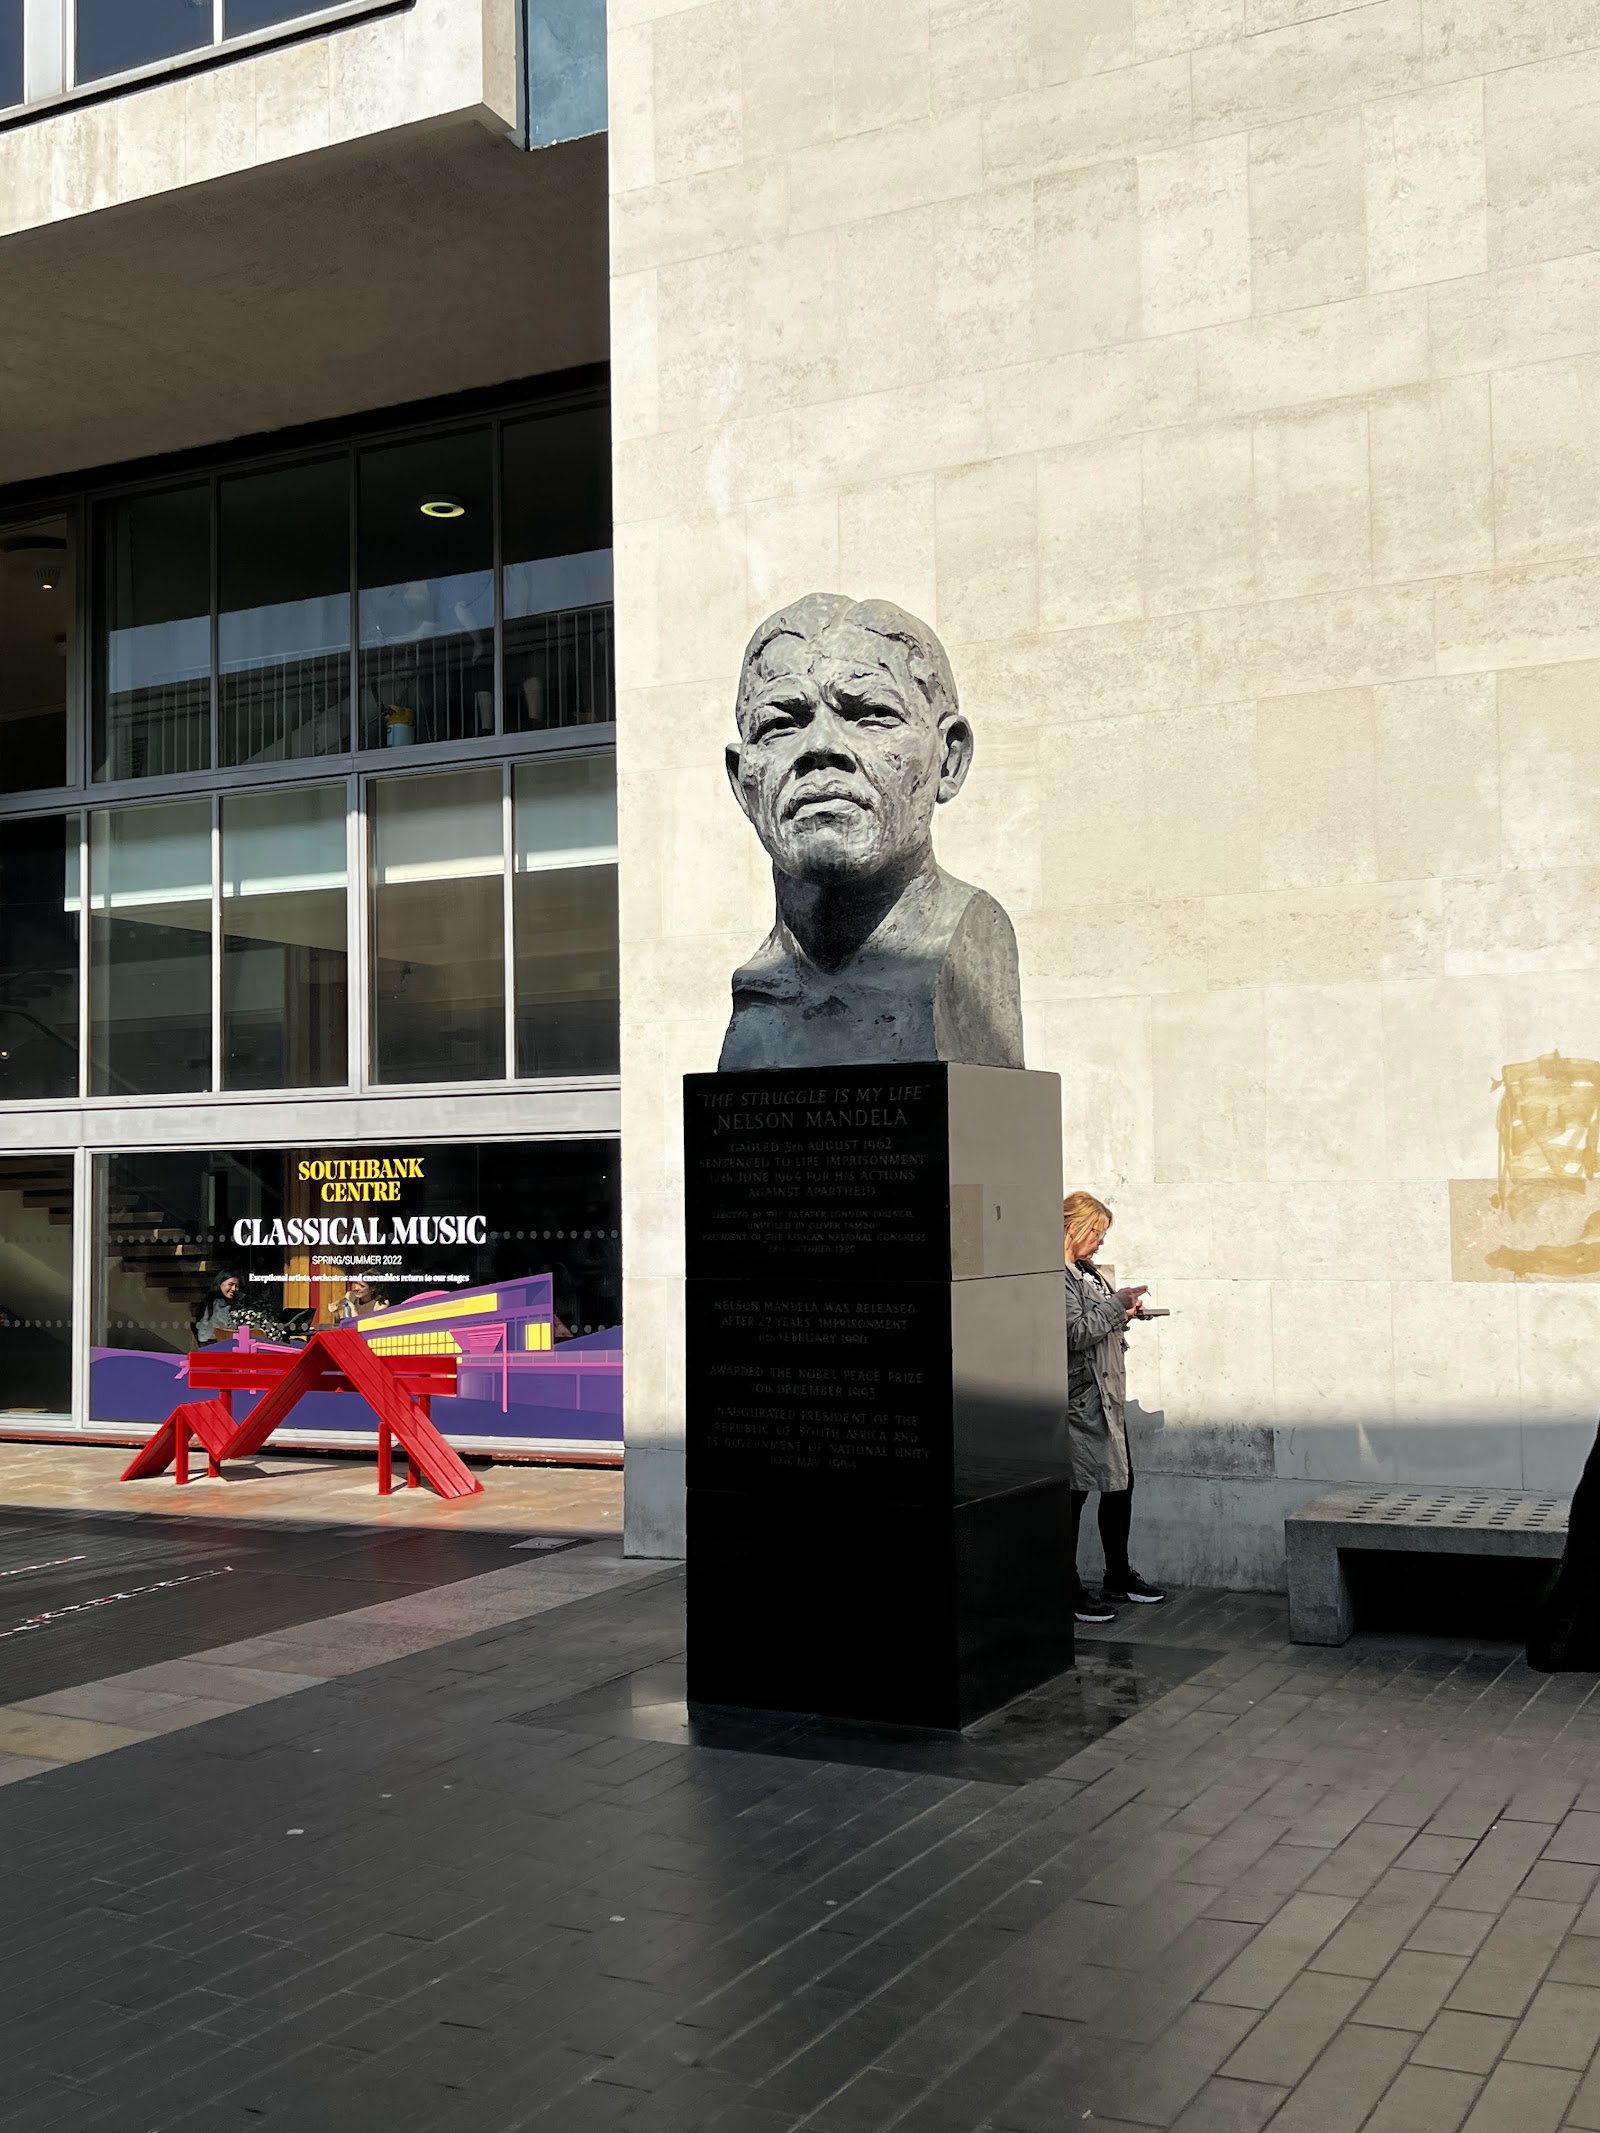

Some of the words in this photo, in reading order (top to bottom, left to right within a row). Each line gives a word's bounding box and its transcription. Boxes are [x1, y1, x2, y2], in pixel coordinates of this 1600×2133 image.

[740, 1090, 827, 1106] STRUGGLE
[834, 1088, 849, 1103] IS
[856, 1087, 883, 1102] MY
[713, 1112, 794, 1134] NELSON
[806, 1108, 908, 1127] MANDELA
[808, 1140, 859, 1151] AUGUST
[863, 1137, 892, 1149] 1962
[699, 1157, 770, 1168] SENTENCED
[774, 1157, 790, 1167] TO
[795, 1156, 820, 1167] LIFE
[826, 1154, 926, 1166] IMPRISONMENT
[298, 1158, 425, 1180] SOUTHBANK
[736, 1172, 769, 1182] JUNE
[775, 1172, 801, 1183] 1964
[806, 1171, 829, 1181] FOR
[834, 1171, 854, 1181] HIS
[860, 1170, 916, 1180] ACTIONS
[321, 1182, 400, 1202] CENTRE
[748, 1187, 800, 1198] AGAINST
[806, 1186, 876, 1197] APARTHEID
[233, 1217, 386, 1246] CLASSICAL
[392, 1216, 486, 1244] MUSIC
[809, 1222, 840, 1230] OLIVER
[876, 1233, 926, 1241] CONGRESS
[312, 1255, 381, 1265] SPRING/SUMMER
[382, 1255, 402, 1265] 2022
[249, 1273, 288, 1284] Exceptional
[288, 1274, 312, 1282] artists,
[312, 1274, 348, 1282] orchestras
[348, 1273, 362, 1282] and
[362, 1273, 400, 1282] ensembles
[446, 1274, 470, 1284] stages
[714, 1300, 759, 1311] NELSON
[764, 1301, 819, 1312] MANDELA
[824, 1302, 850, 1313] WAS
[855, 1303, 916, 1314] RELEASED
[721, 1315, 754, 1326] AFTER
[758, 1316, 772, 1327] 27
[775, 1316, 810, 1328] YEARS
[819, 1318, 908, 1330] IMPRISONMENT
[841, 1334, 868, 1345] 1990
[710, 1365, 764, 1377] AWARDED
[770, 1367, 792, 1378] THE
[798, 1368, 838, 1379] NOBEL
[843, 1369, 881, 1381] PEACE
[888, 1372, 923, 1383] PRIZE
[777, 1384, 842, 1397] DECEMBER
[847, 1386, 876, 1400] 1993
[713, 1407, 796, 1420] INAUGURATED
[800, 1410, 868, 1424] PRESIDENT
[873, 1414, 890, 1425] OF
[895, 1415, 918, 1427] THE
[713, 1422, 769, 1434] REPUBLIC
[776, 1425, 791, 1437] OF
[799, 1426, 840, 1439] SOUTH
[846, 1429, 887, 1441] AFRICA
[893, 1431, 918, 1443] AND
[808, 1441, 824, 1453] OF
[828, 1443, 888, 1457] NATIONAL
[895, 1448, 930, 1460] UNITY
[797, 1457, 820, 1468] MAY
